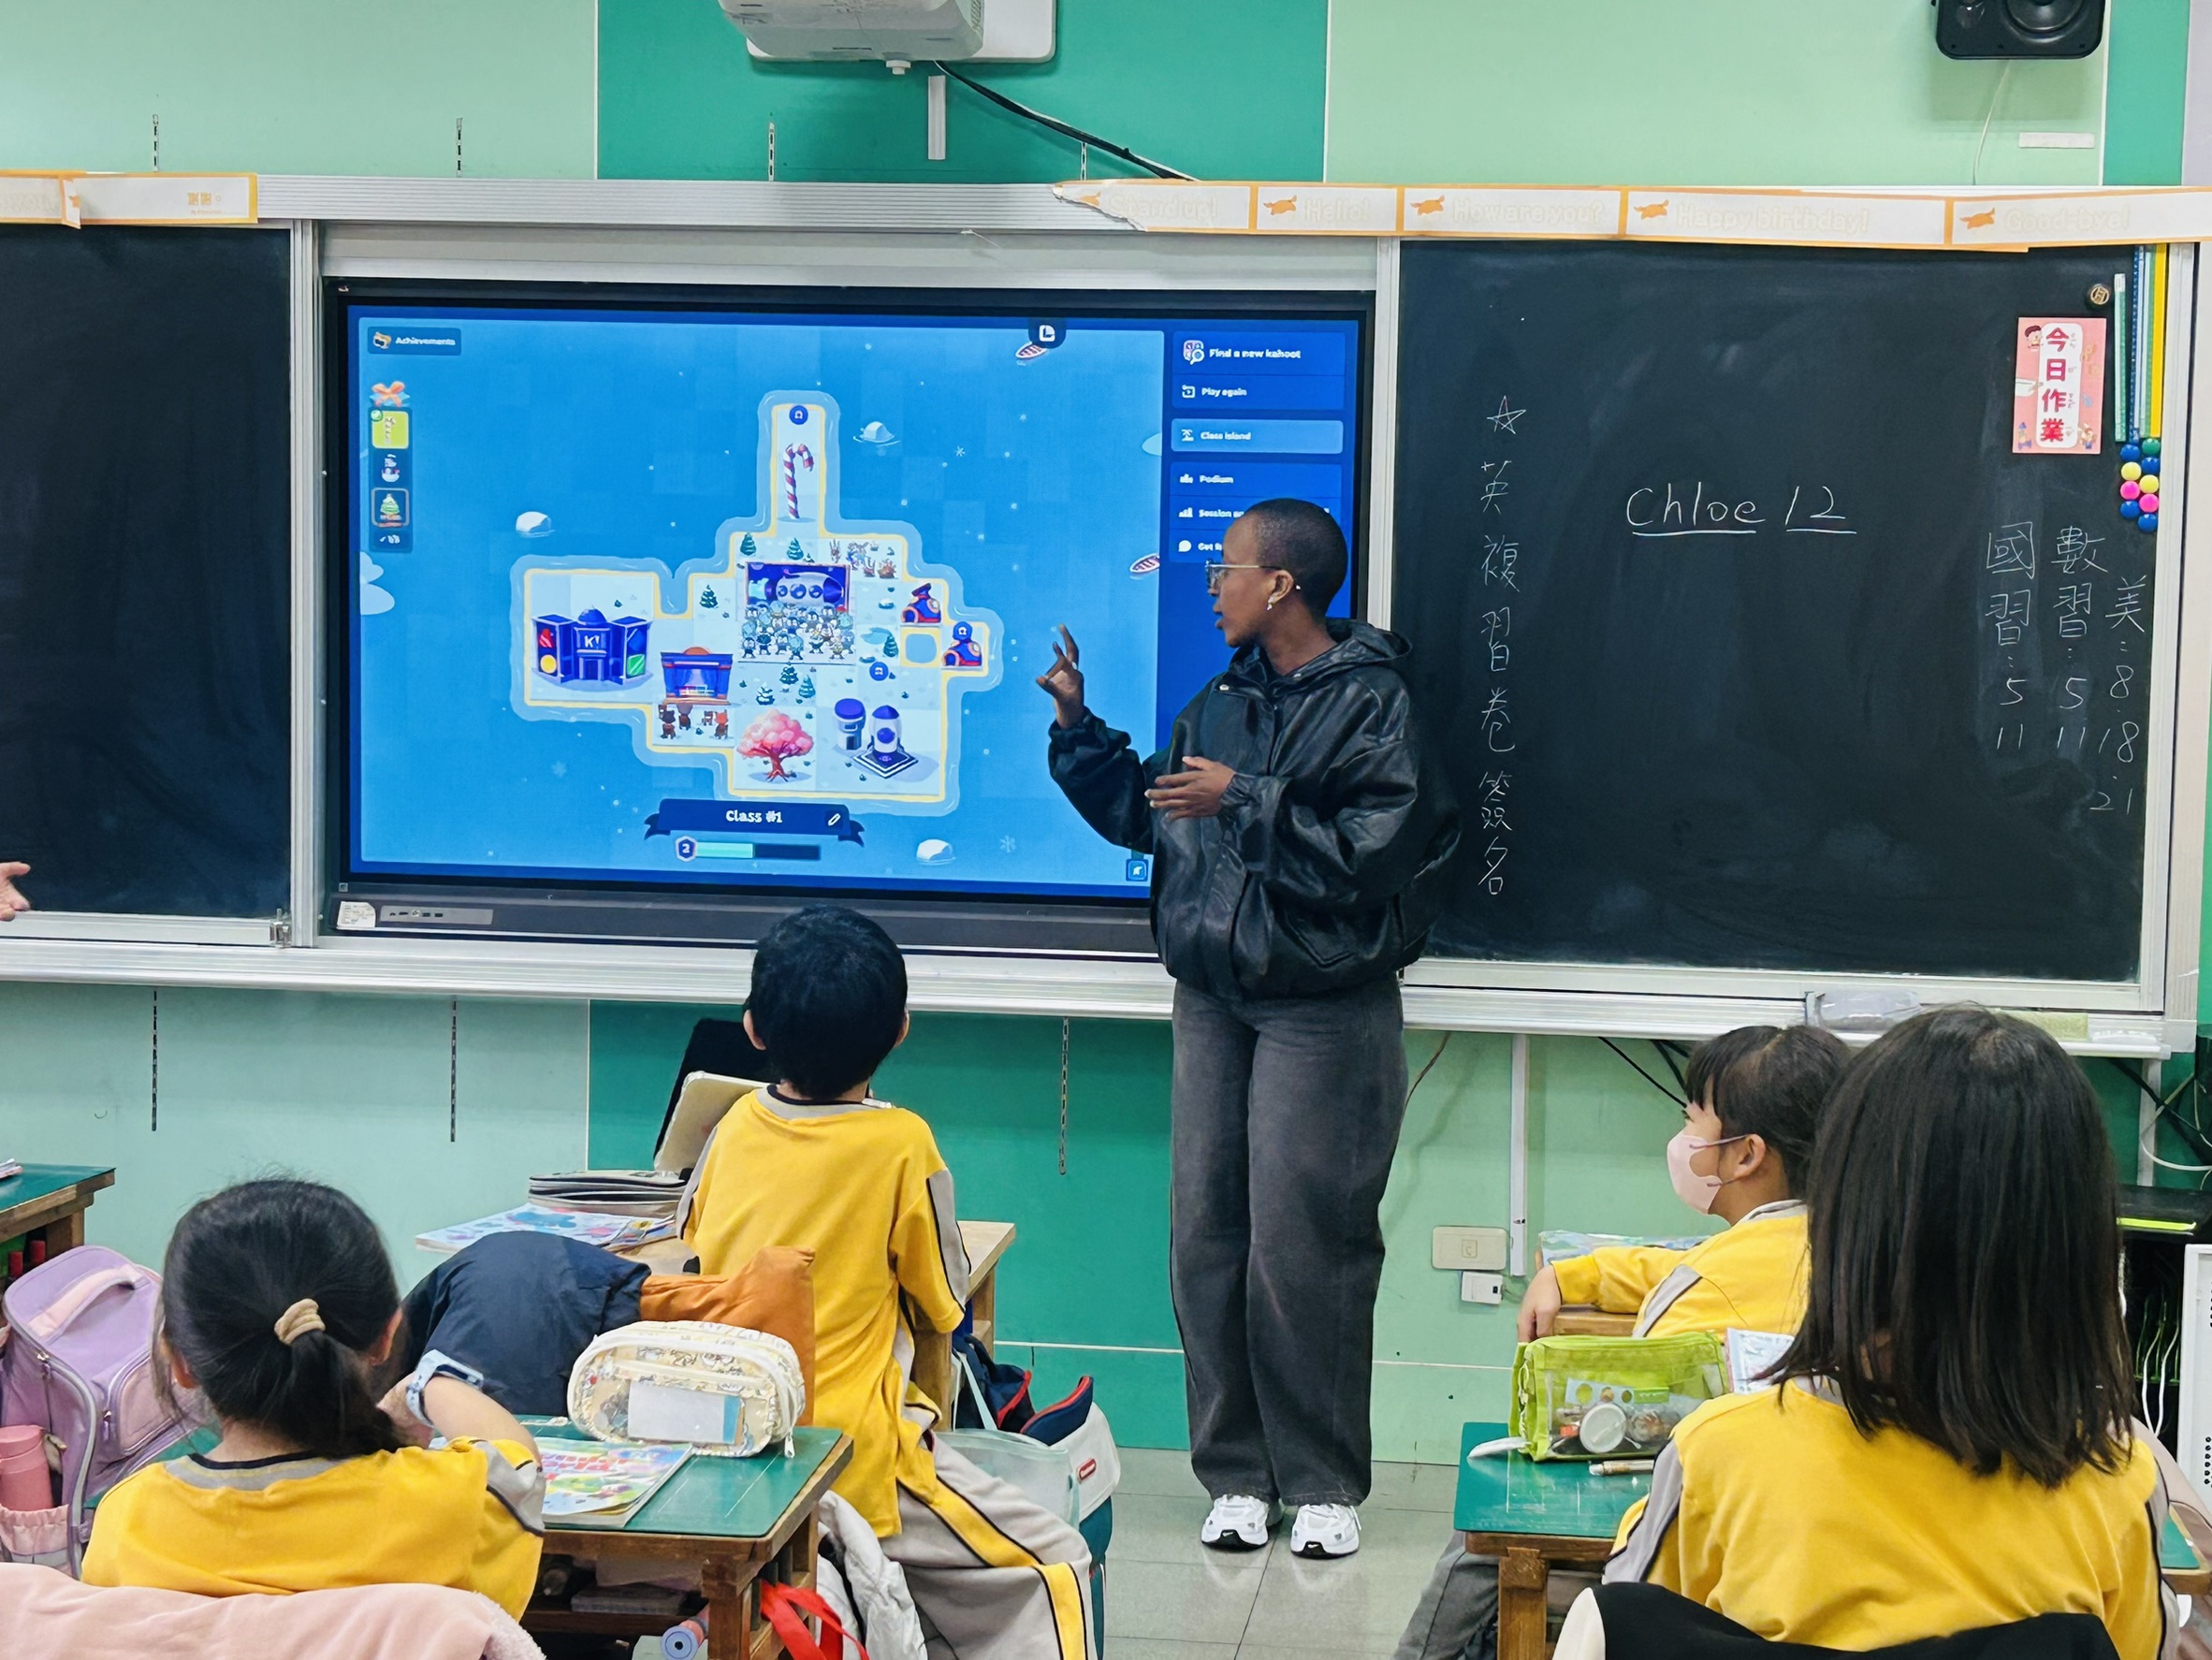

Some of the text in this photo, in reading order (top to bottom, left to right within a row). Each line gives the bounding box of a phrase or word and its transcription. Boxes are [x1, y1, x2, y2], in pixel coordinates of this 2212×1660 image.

[1303, 196, 1371, 224] Hello!
[1452, 196, 1605, 226] How are you?
[1676, 202, 1870, 234] Happy birthday!
[395, 336, 456, 345] Achievements
[1209, 348, 1231, 357] Find
[2040, 327, 2070, 442] 今日作業
[1201, 387, 1247, 397] Play again
[1201, 431, 1223, 440] Class
[1199, 474, 1234, 483] Podium
[1626, 481, 1847, 527] Chloe 12
[725, 809, 782, 823] Class #1
[681, 843, 691, 854] 2
